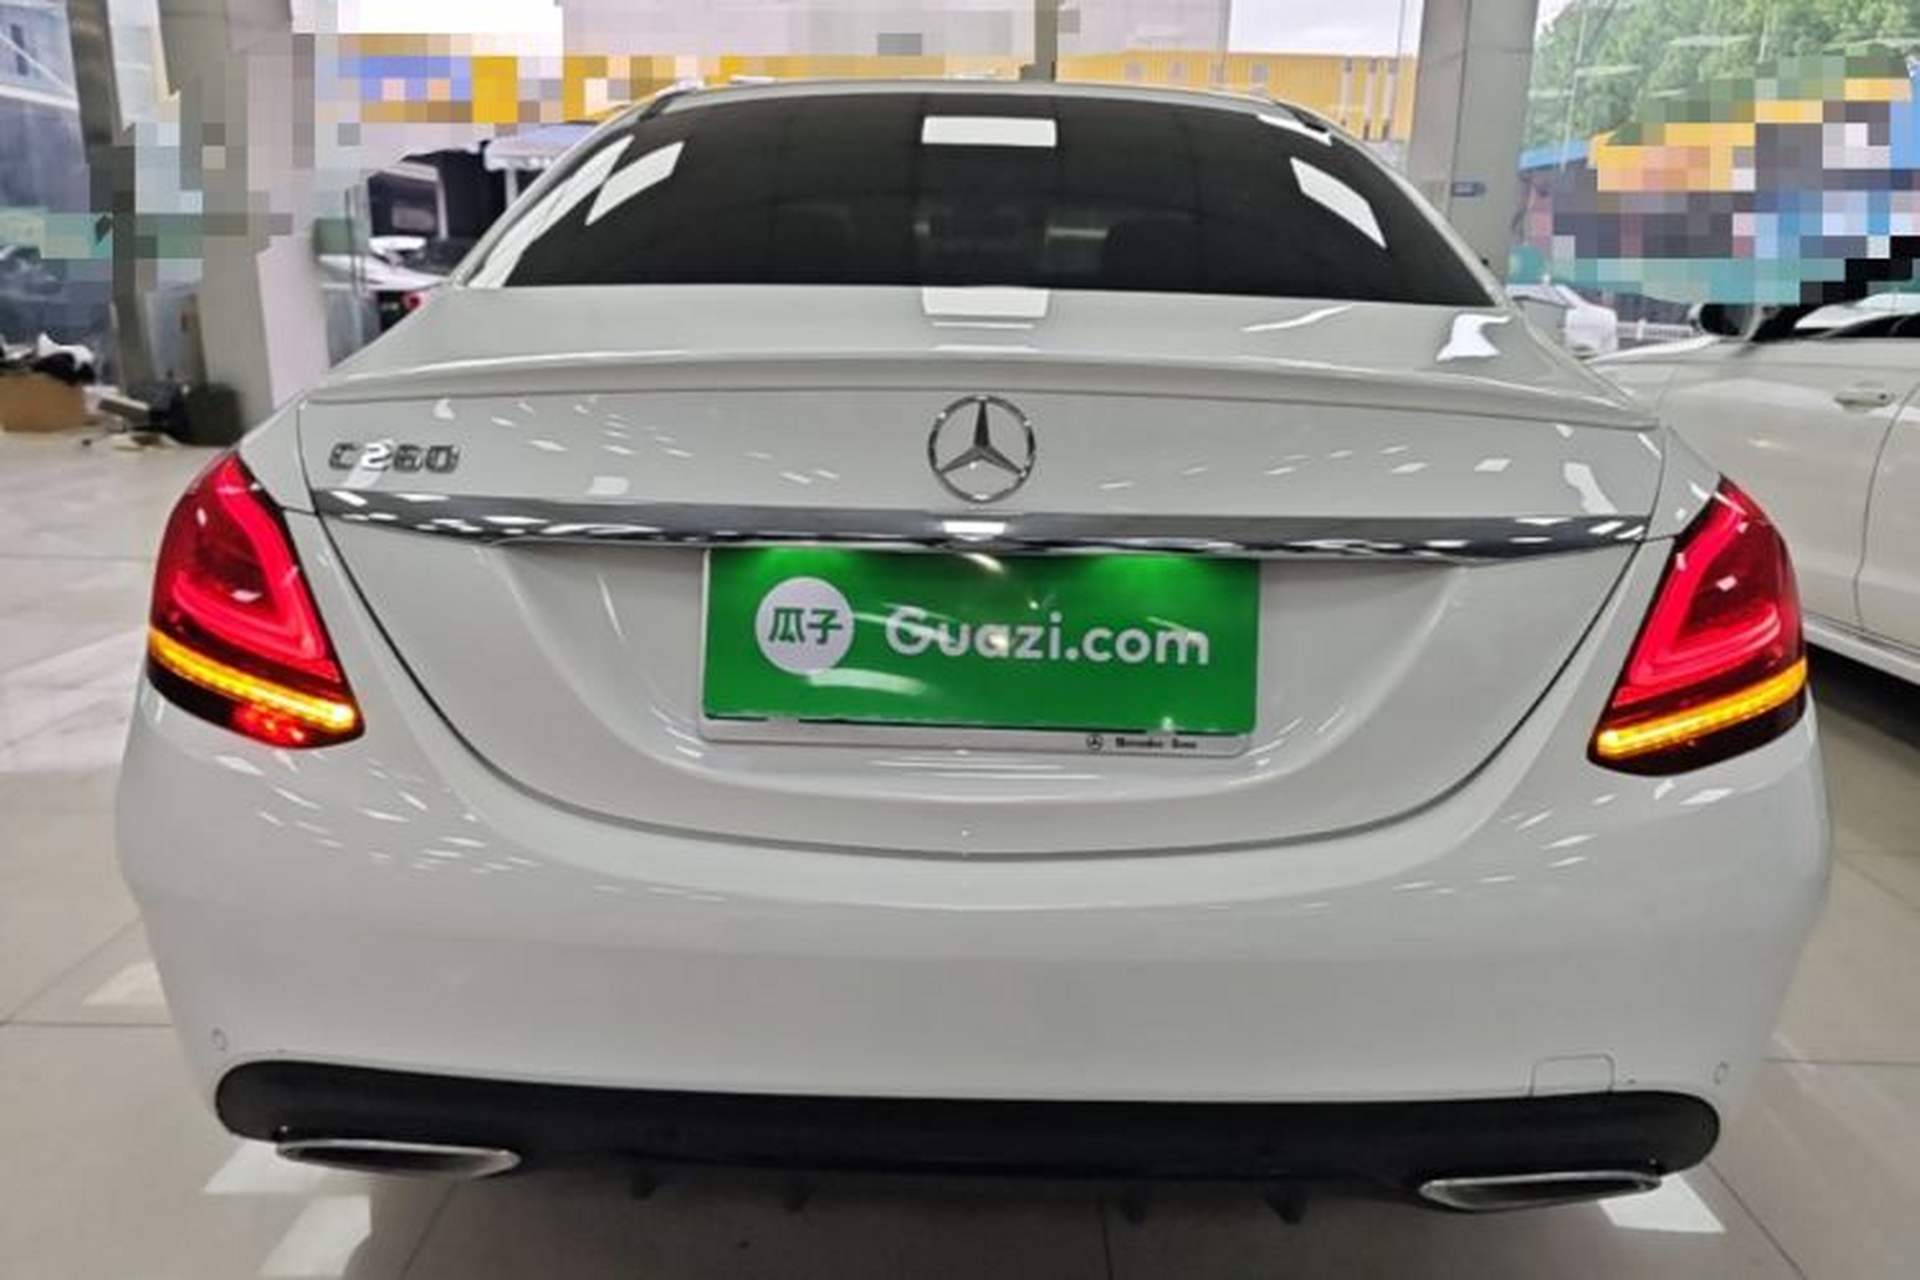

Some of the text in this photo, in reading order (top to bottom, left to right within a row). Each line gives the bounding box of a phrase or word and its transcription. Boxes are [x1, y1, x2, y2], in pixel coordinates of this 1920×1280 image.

[329, 439, 461, 474] C260
[768, 606, 844, 645] 瓜子
[885, 604, 1210, 666] Guazi.com
